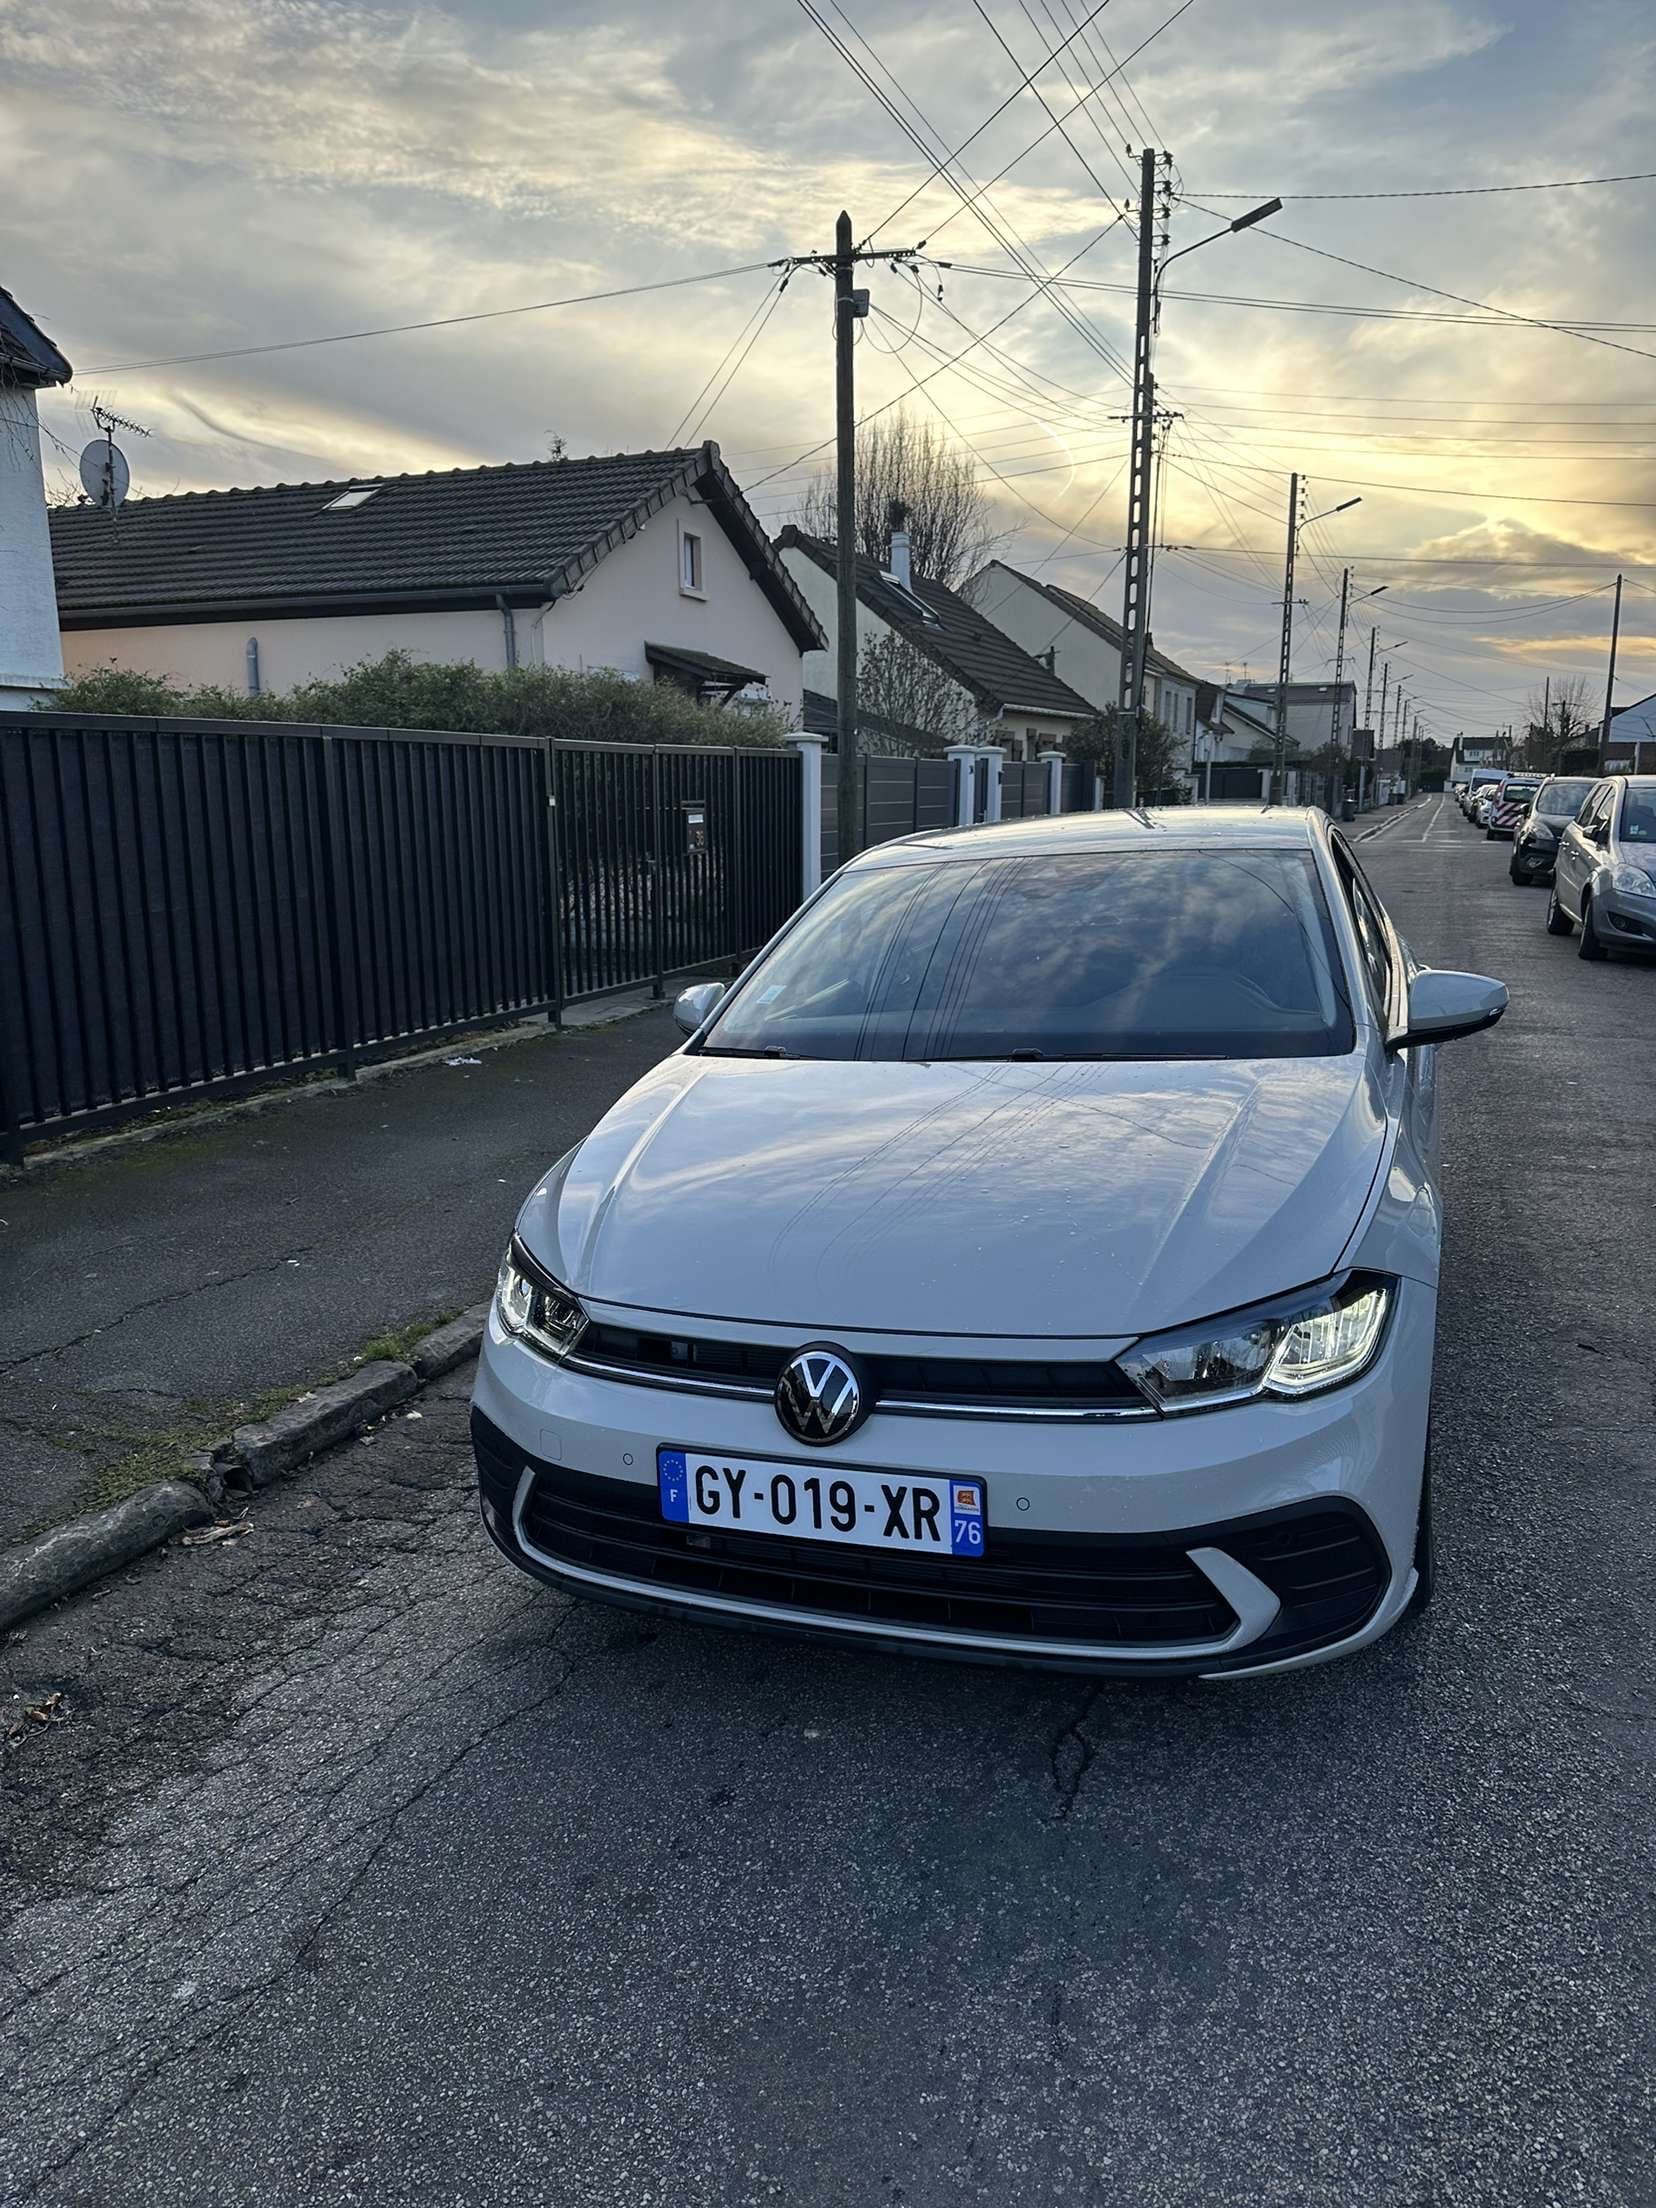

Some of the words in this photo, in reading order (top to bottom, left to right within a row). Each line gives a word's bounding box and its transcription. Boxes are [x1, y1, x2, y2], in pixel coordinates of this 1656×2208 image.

[779, 1351, 859, 1441] VW
[670, 1488, 678, 1503] F
[695, 1465, 941, 1542] GY-019-XR
[955, 1519, 981, 1544] 76
